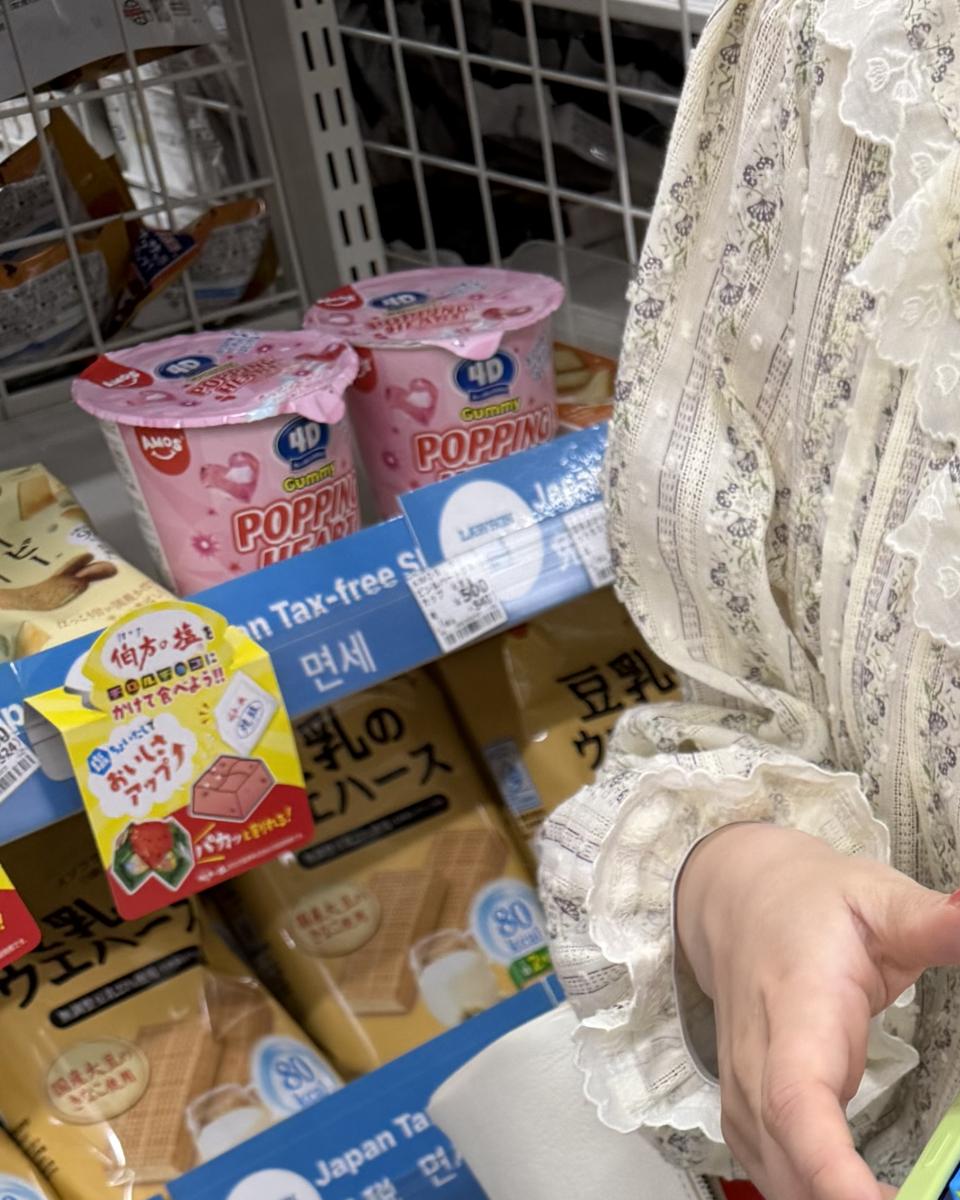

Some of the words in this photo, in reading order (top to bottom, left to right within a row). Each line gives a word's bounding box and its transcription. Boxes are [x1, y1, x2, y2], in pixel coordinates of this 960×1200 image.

[467, 360, 504, 389] 4D
[460, 397, 521, 422] Gummy
[141, 434, 184, 452] AMOS
[289, 419, 321, 453] 4D
[413, 406, 551, 472] POPPING
[282, 463, 336, 493] Gummy
[269, 565, 399, 631] Tax-free
[299, 629, 379, 694] 면세
[299, 706, 406, 779] 乳の
[494, 901, 533, 938] 80
[276, 1056, 315, 1092] 80
[314, 1128, 398, 1188] Japan
[392, 1109, 431, 1139] Ta
